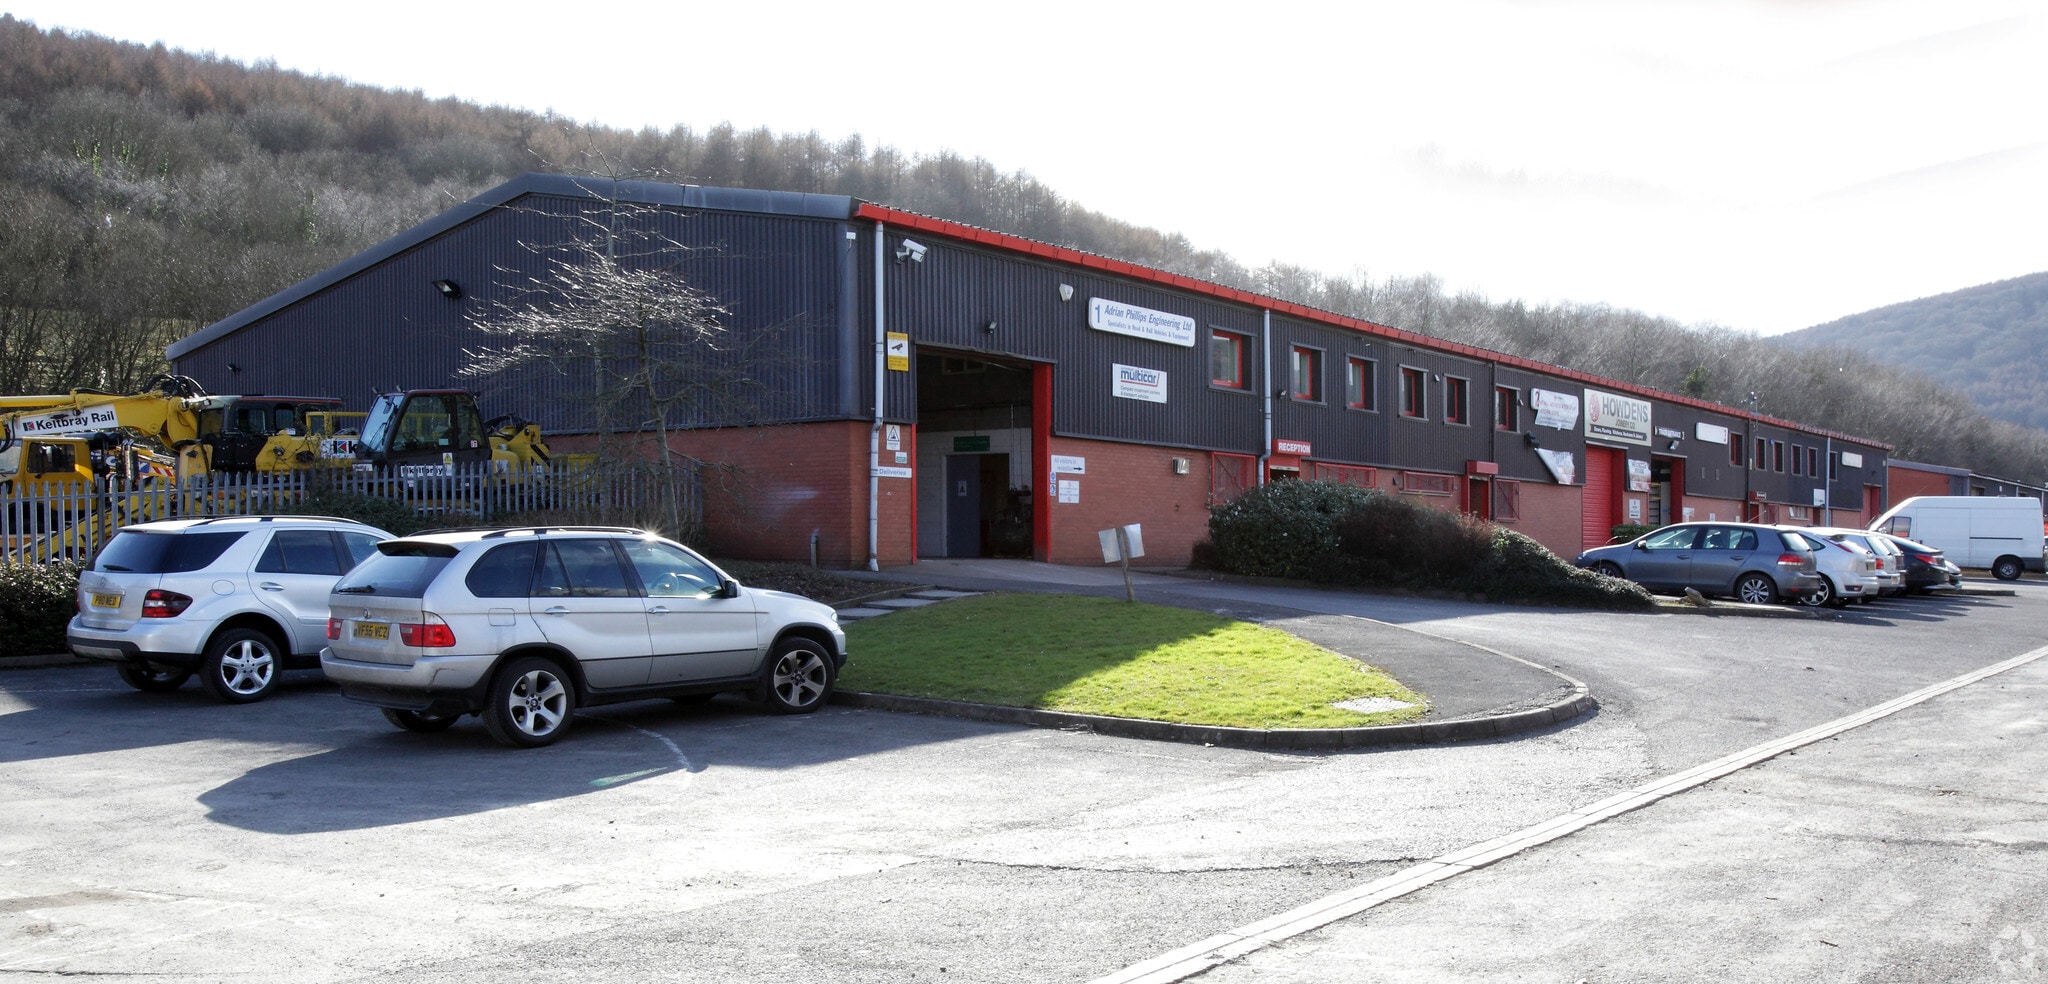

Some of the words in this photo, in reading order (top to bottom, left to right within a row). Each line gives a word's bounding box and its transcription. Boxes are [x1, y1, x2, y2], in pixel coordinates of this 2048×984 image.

[1095, 304, 1100, 323] 1
[1104, 305, 1124, 317] Adrian
[1125, 309, 1147, 322] Phillips
[1148, 314, 1181, 330] Engineering
[1182, 321, 1192, 331] Ltd
[1107, 320, 1126, 329] Specialists
[1121, 370, 1156, 384] multicar
[1602, 396, 1648, 423] HOWDENS
[36, 415, 88, 430] Keltbray
[91, 411, 115, 423] Rail
[1278, 442, 1310, 453] RECEPTION
